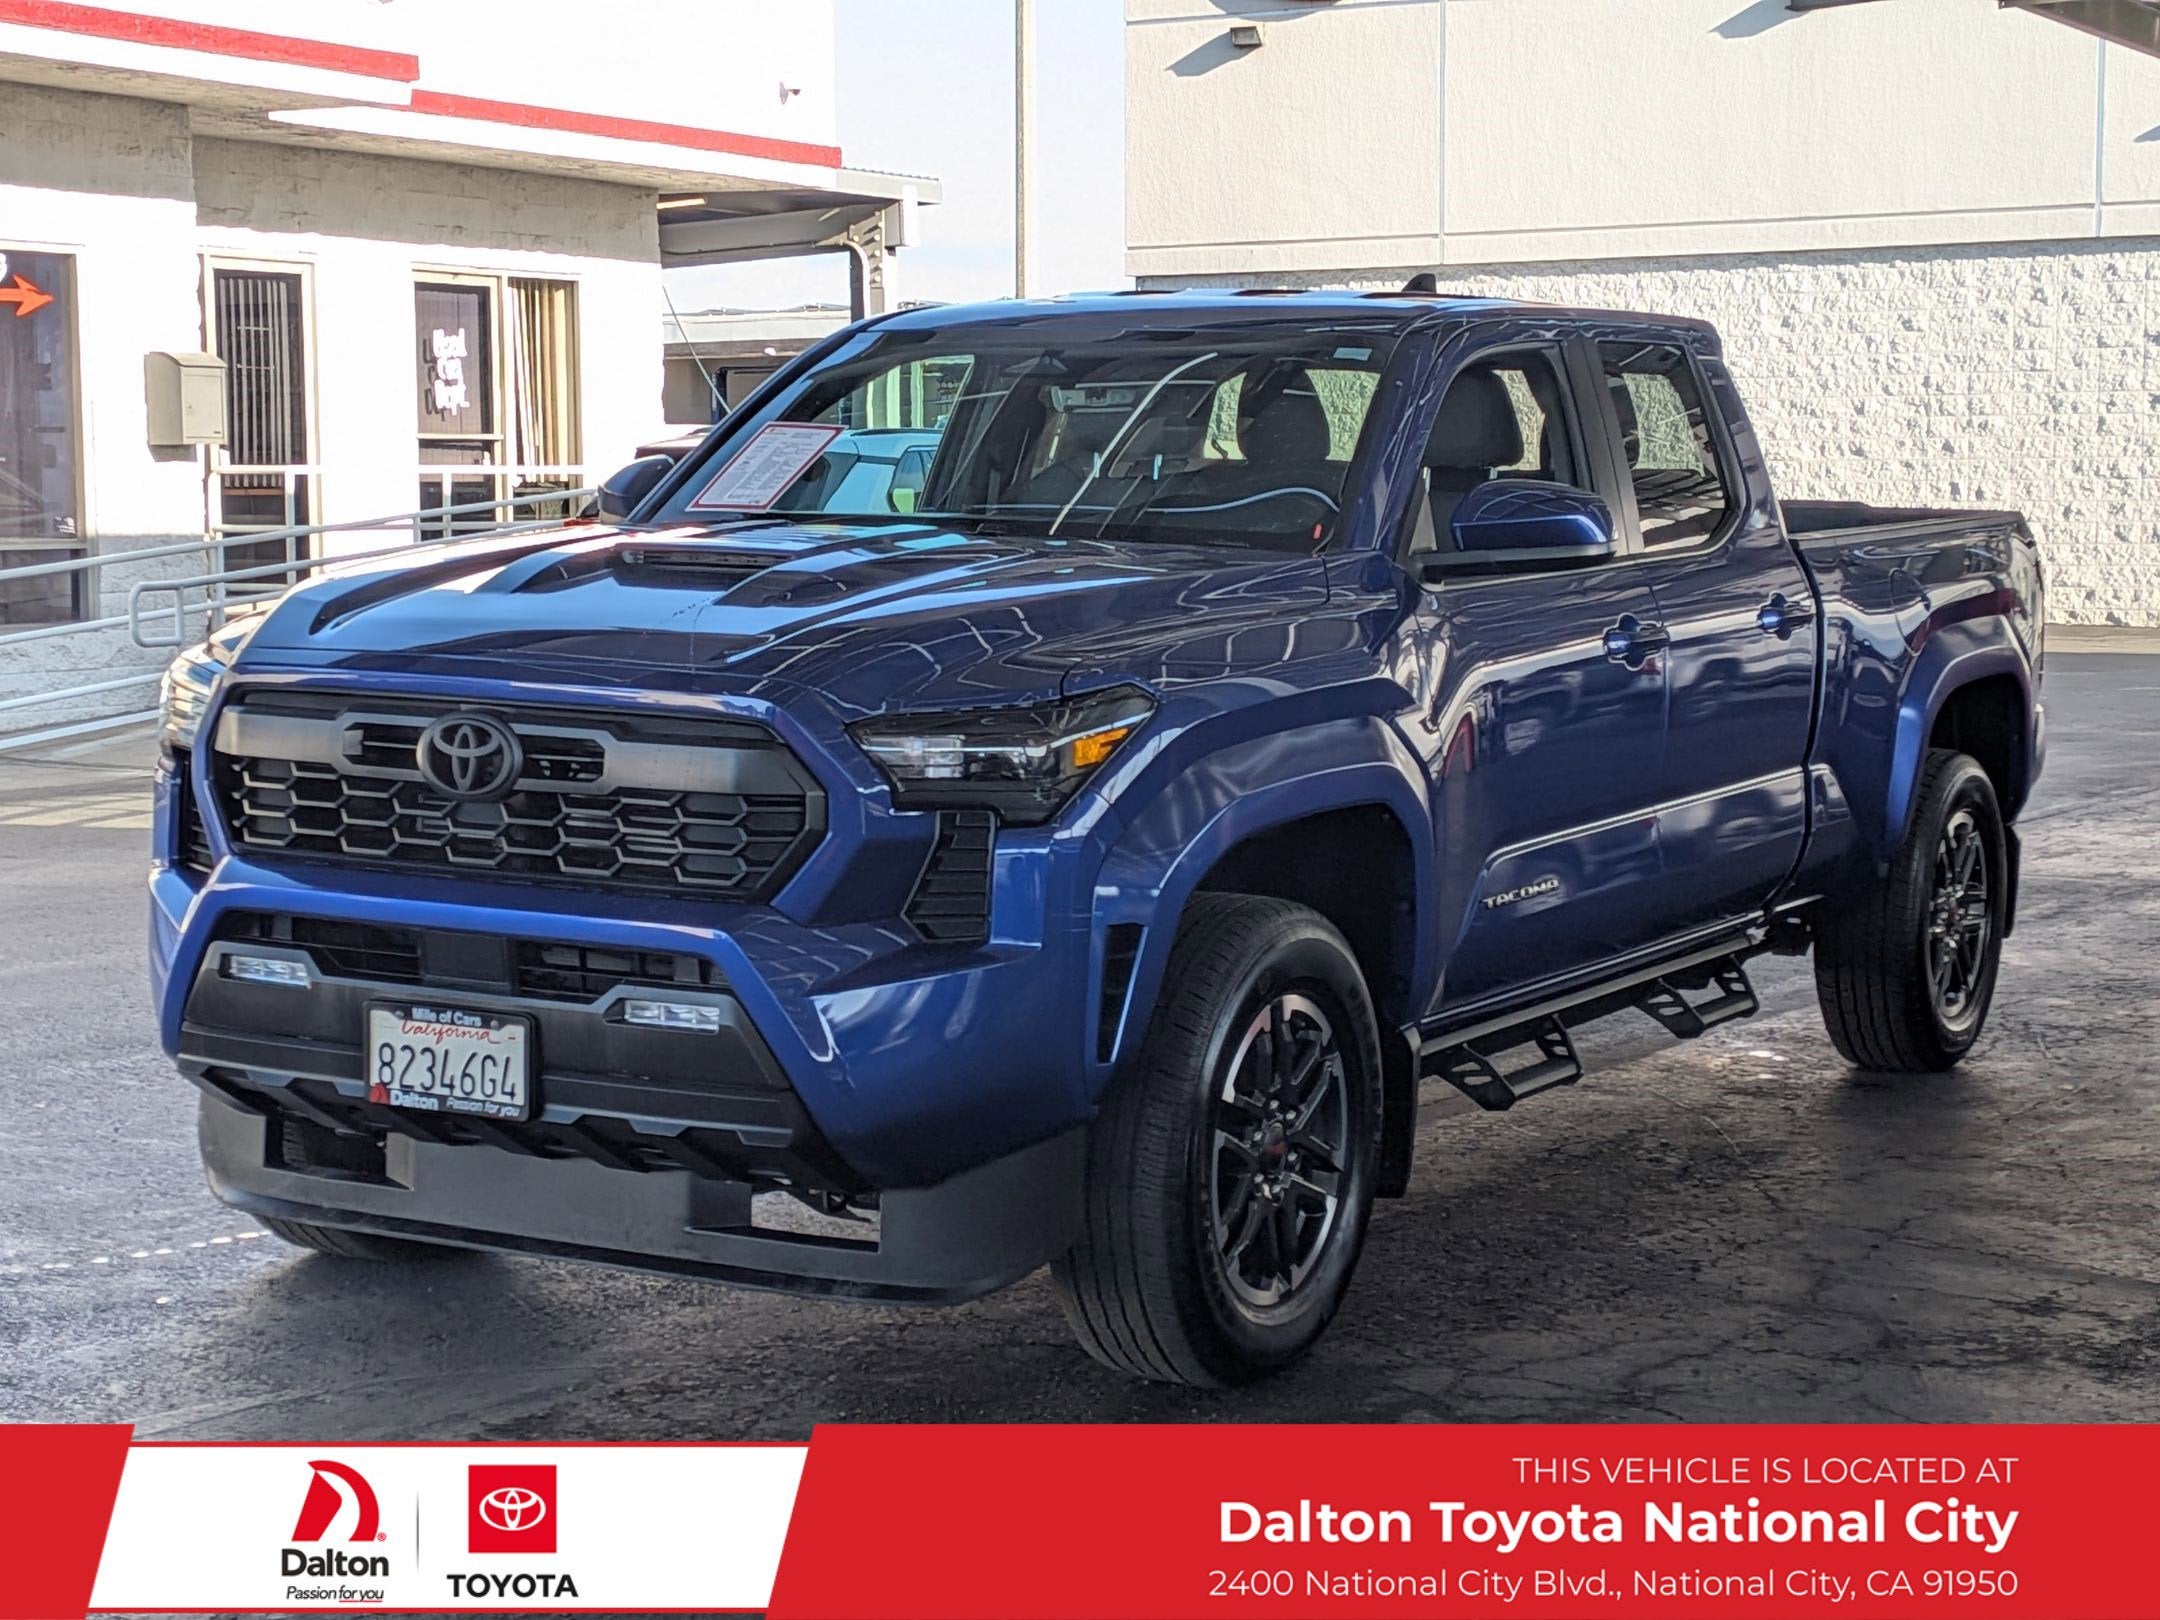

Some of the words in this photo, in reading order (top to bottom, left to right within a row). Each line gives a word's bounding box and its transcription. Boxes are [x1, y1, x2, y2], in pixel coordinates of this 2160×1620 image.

[1482, 879, 1559, 909] TACOMA
[411, 1007, 437, 1021] Mile
[439, 1010, 453, 1023] of
[453, 1012, 482, 1027] Cars
[401, 1019, 501, 1045] California
[378, 1042, 516, 1101] 82346G4
[390, 1090, 439, 1111] Dalton
[500, 1105, 521, 1118] you
